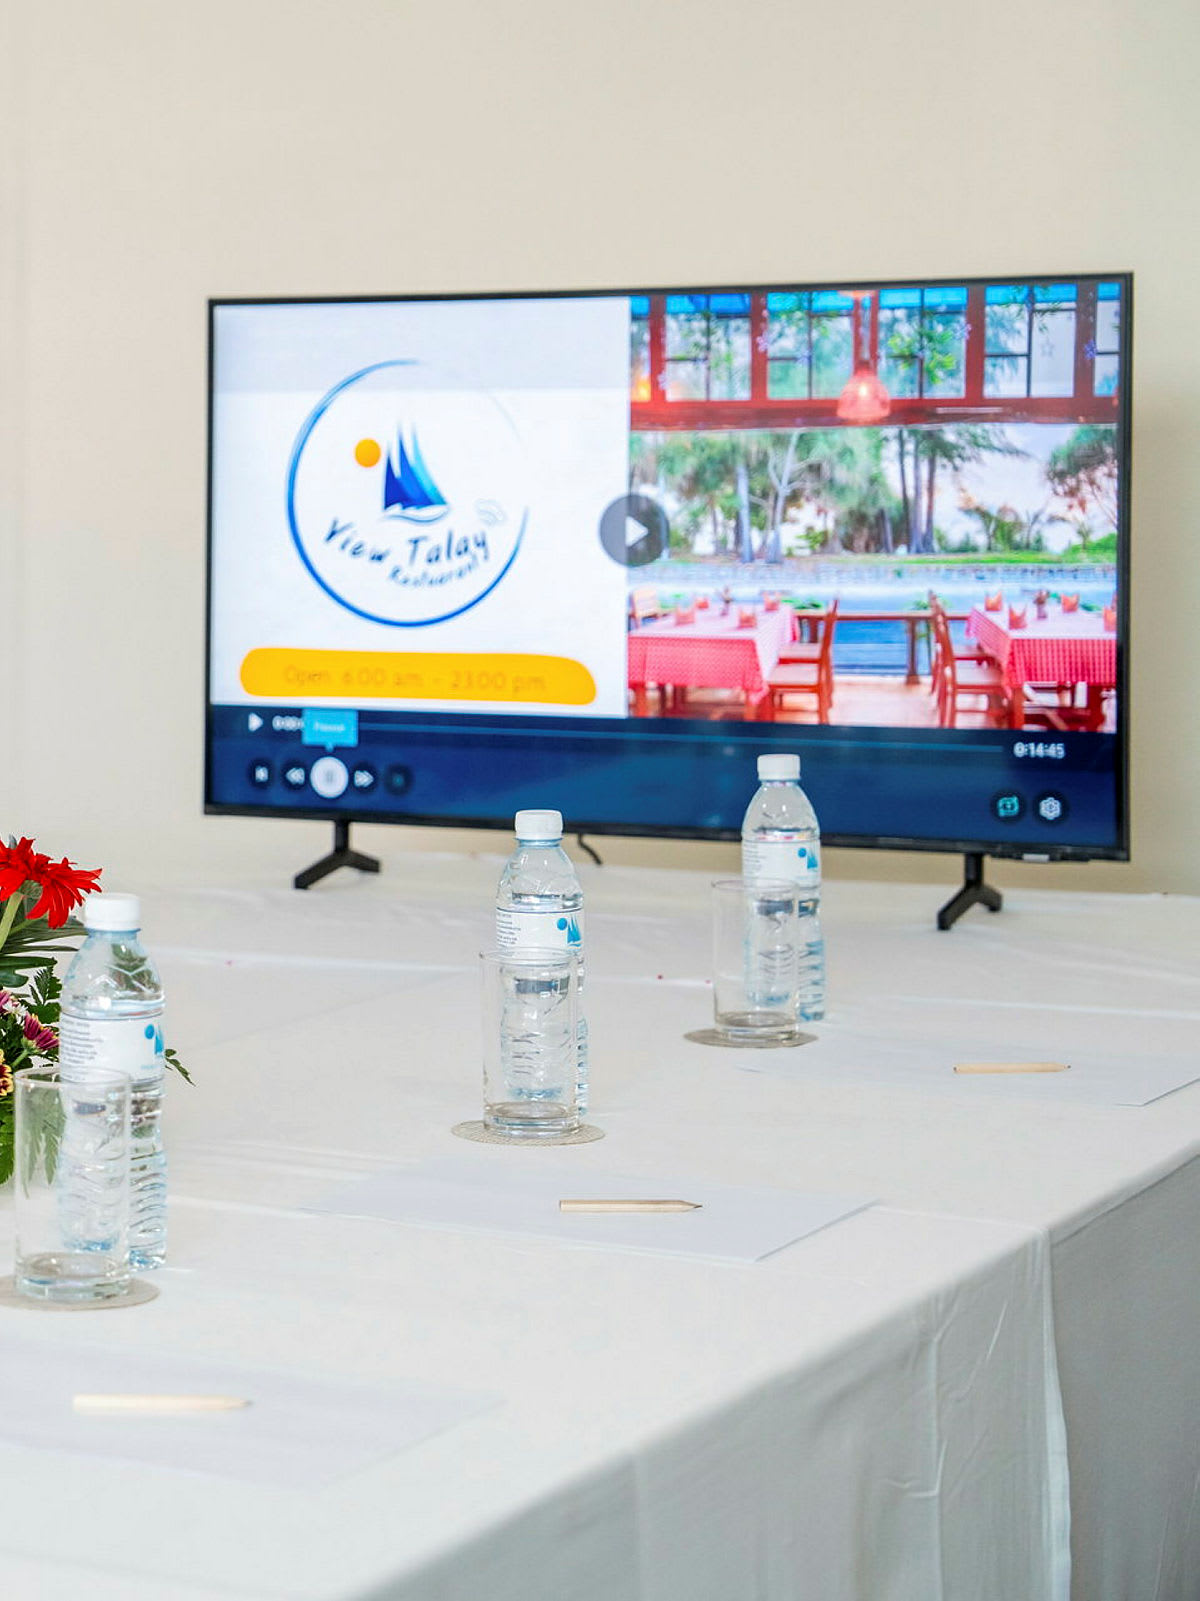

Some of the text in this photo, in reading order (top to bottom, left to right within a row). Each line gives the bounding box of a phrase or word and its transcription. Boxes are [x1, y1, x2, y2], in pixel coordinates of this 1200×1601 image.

[324, 518, 490, 566] View Talay
[1013, 741, 1066, 759] 0:14:45
